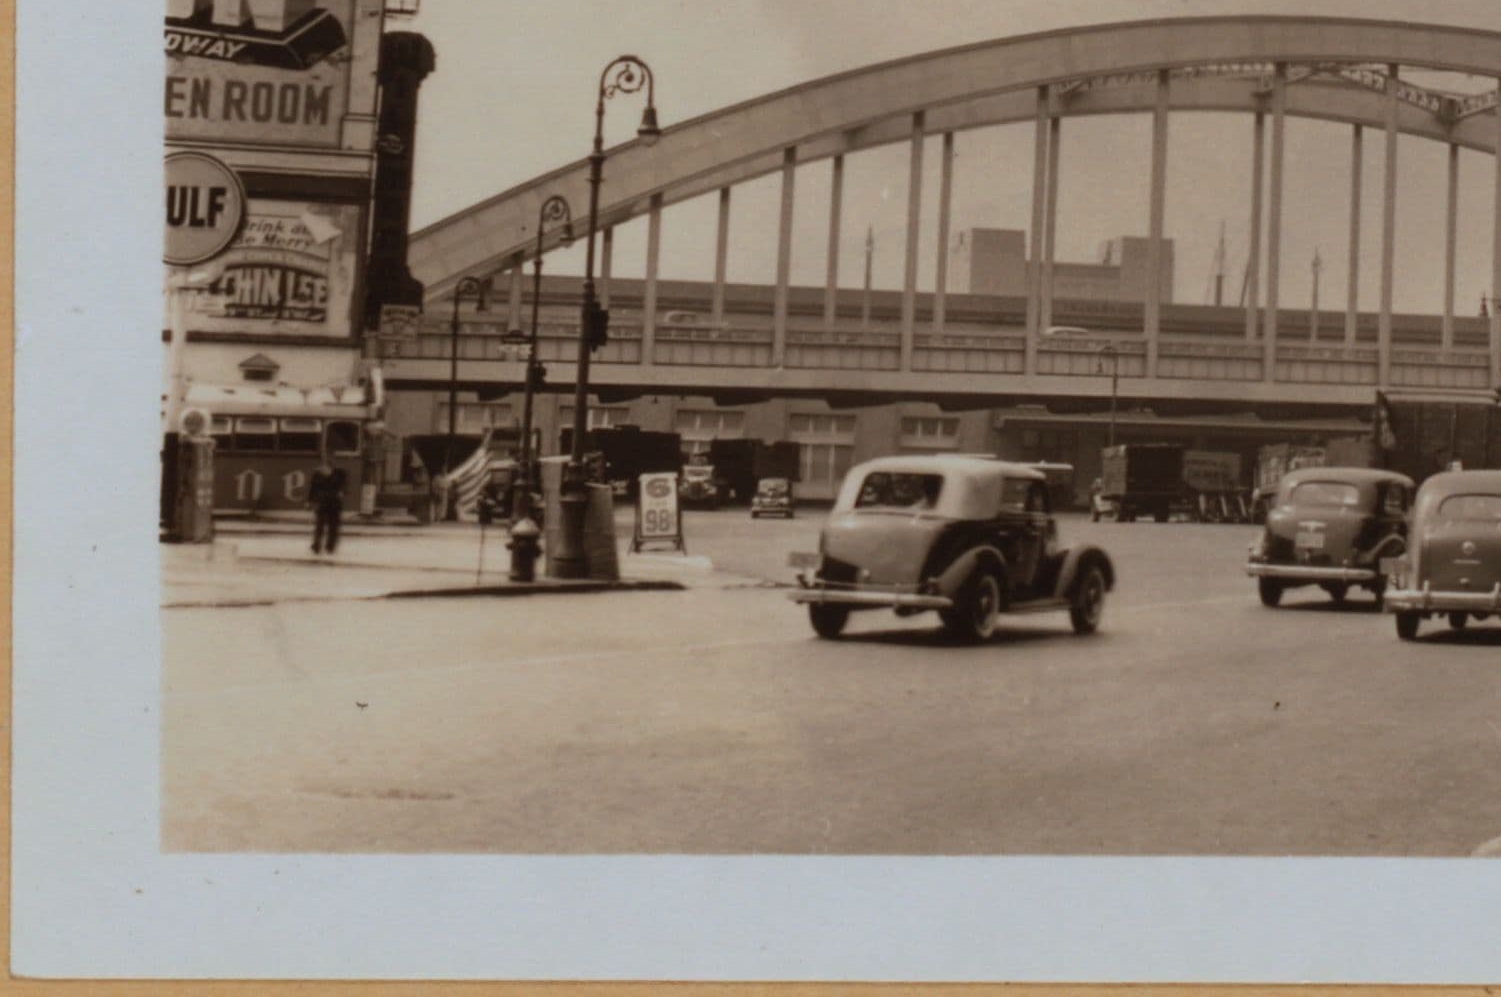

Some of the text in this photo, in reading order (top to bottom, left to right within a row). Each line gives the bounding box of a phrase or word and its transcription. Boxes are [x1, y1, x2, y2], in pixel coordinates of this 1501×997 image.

[222, 80, 332, 126] ROOM
[244, 220, 283, 233] rink
[646, 477, 672, 498] 6
